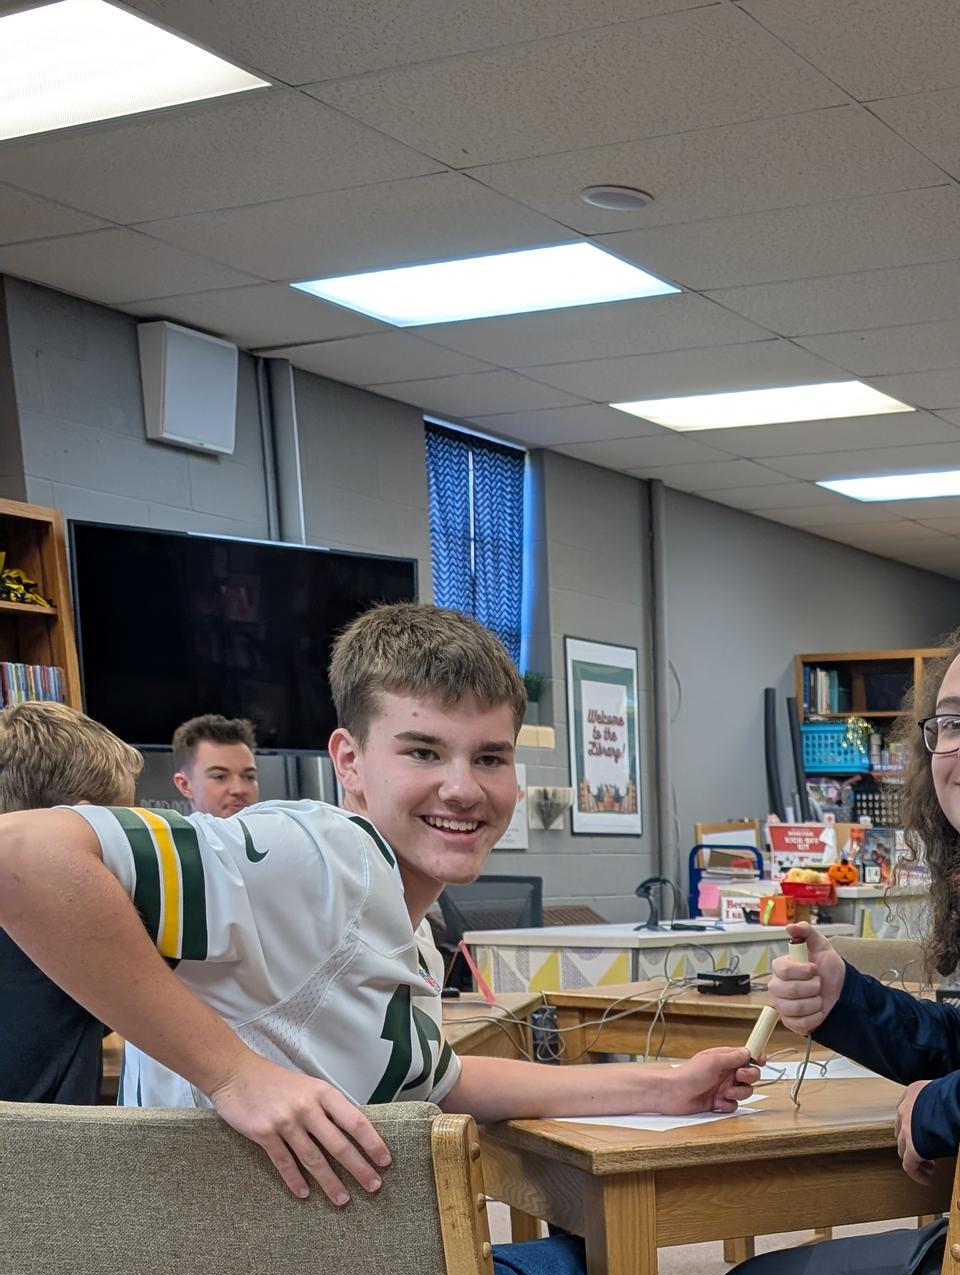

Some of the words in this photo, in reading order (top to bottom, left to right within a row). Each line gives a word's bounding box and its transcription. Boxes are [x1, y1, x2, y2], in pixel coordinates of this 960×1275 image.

[587, 709, 624, 726] Welcome
[593, 726, 602, 740] to
[604, 726, 617, 741] the
[587, 741, 625, 764] Library!
